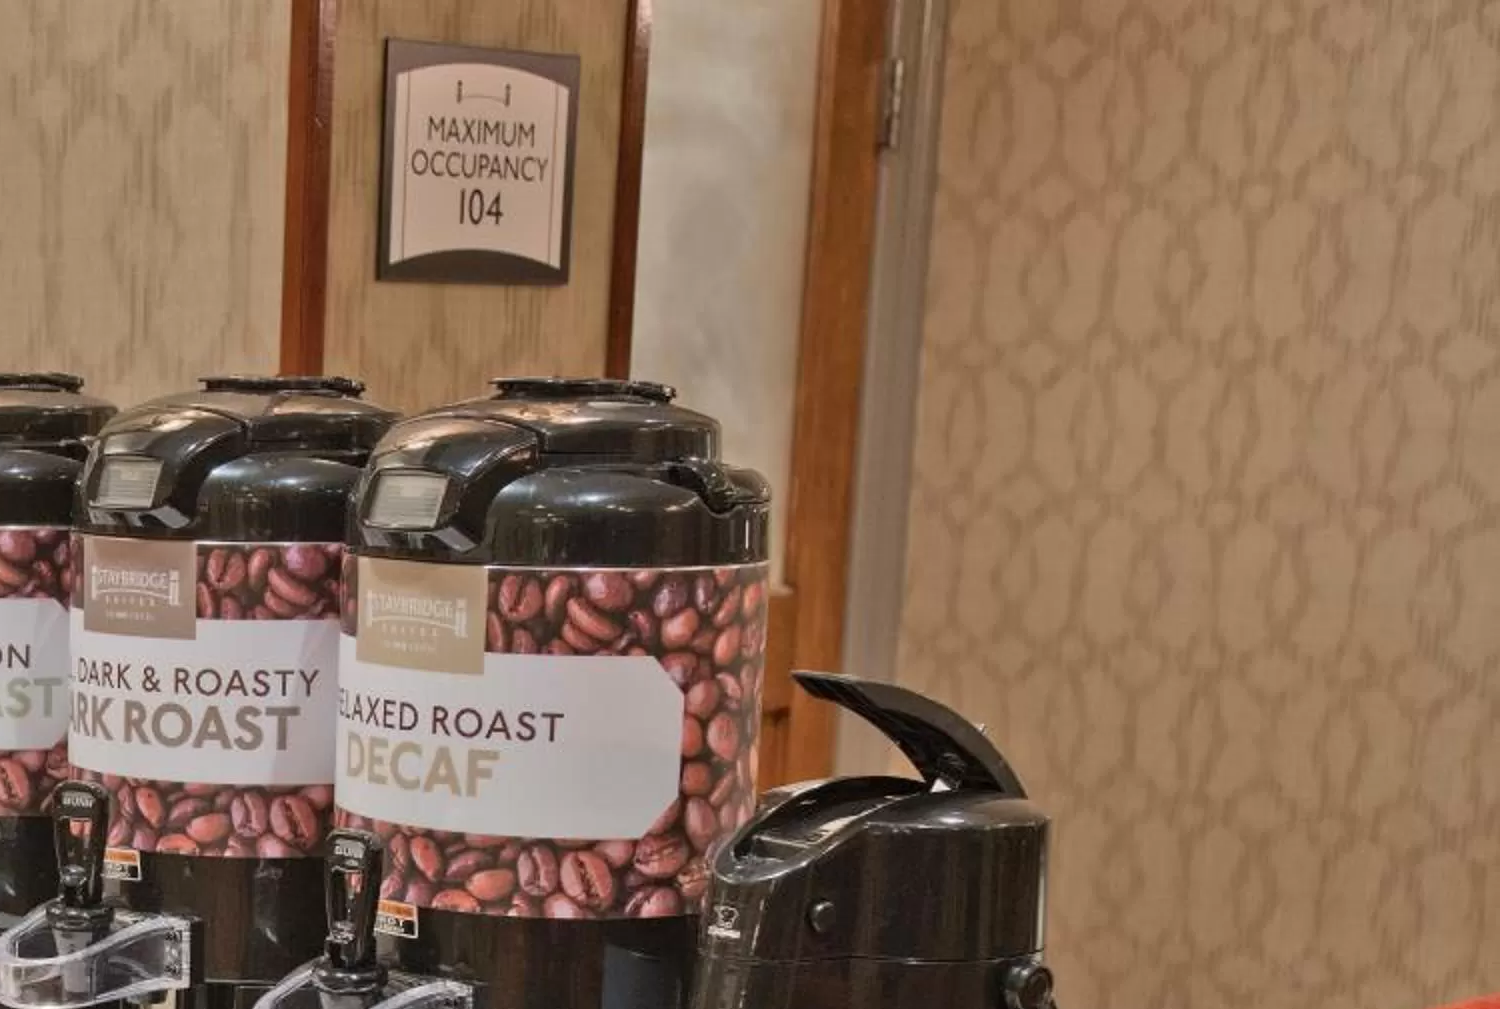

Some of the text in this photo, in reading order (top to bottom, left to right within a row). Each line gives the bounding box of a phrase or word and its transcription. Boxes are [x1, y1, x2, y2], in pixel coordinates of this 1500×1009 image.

[428, 115, 536, 148] MAXIMUM
[411, 149, 549, 181] OCCUPANCY
[459, 187, 504, 225] 104
[78, 656, 320, 697] DARK & ROASTY
[124, 699, 300, 751] ROAST
[431, 705, 565, 743] ROAST
[346, 731, 500, 798] DECAF
